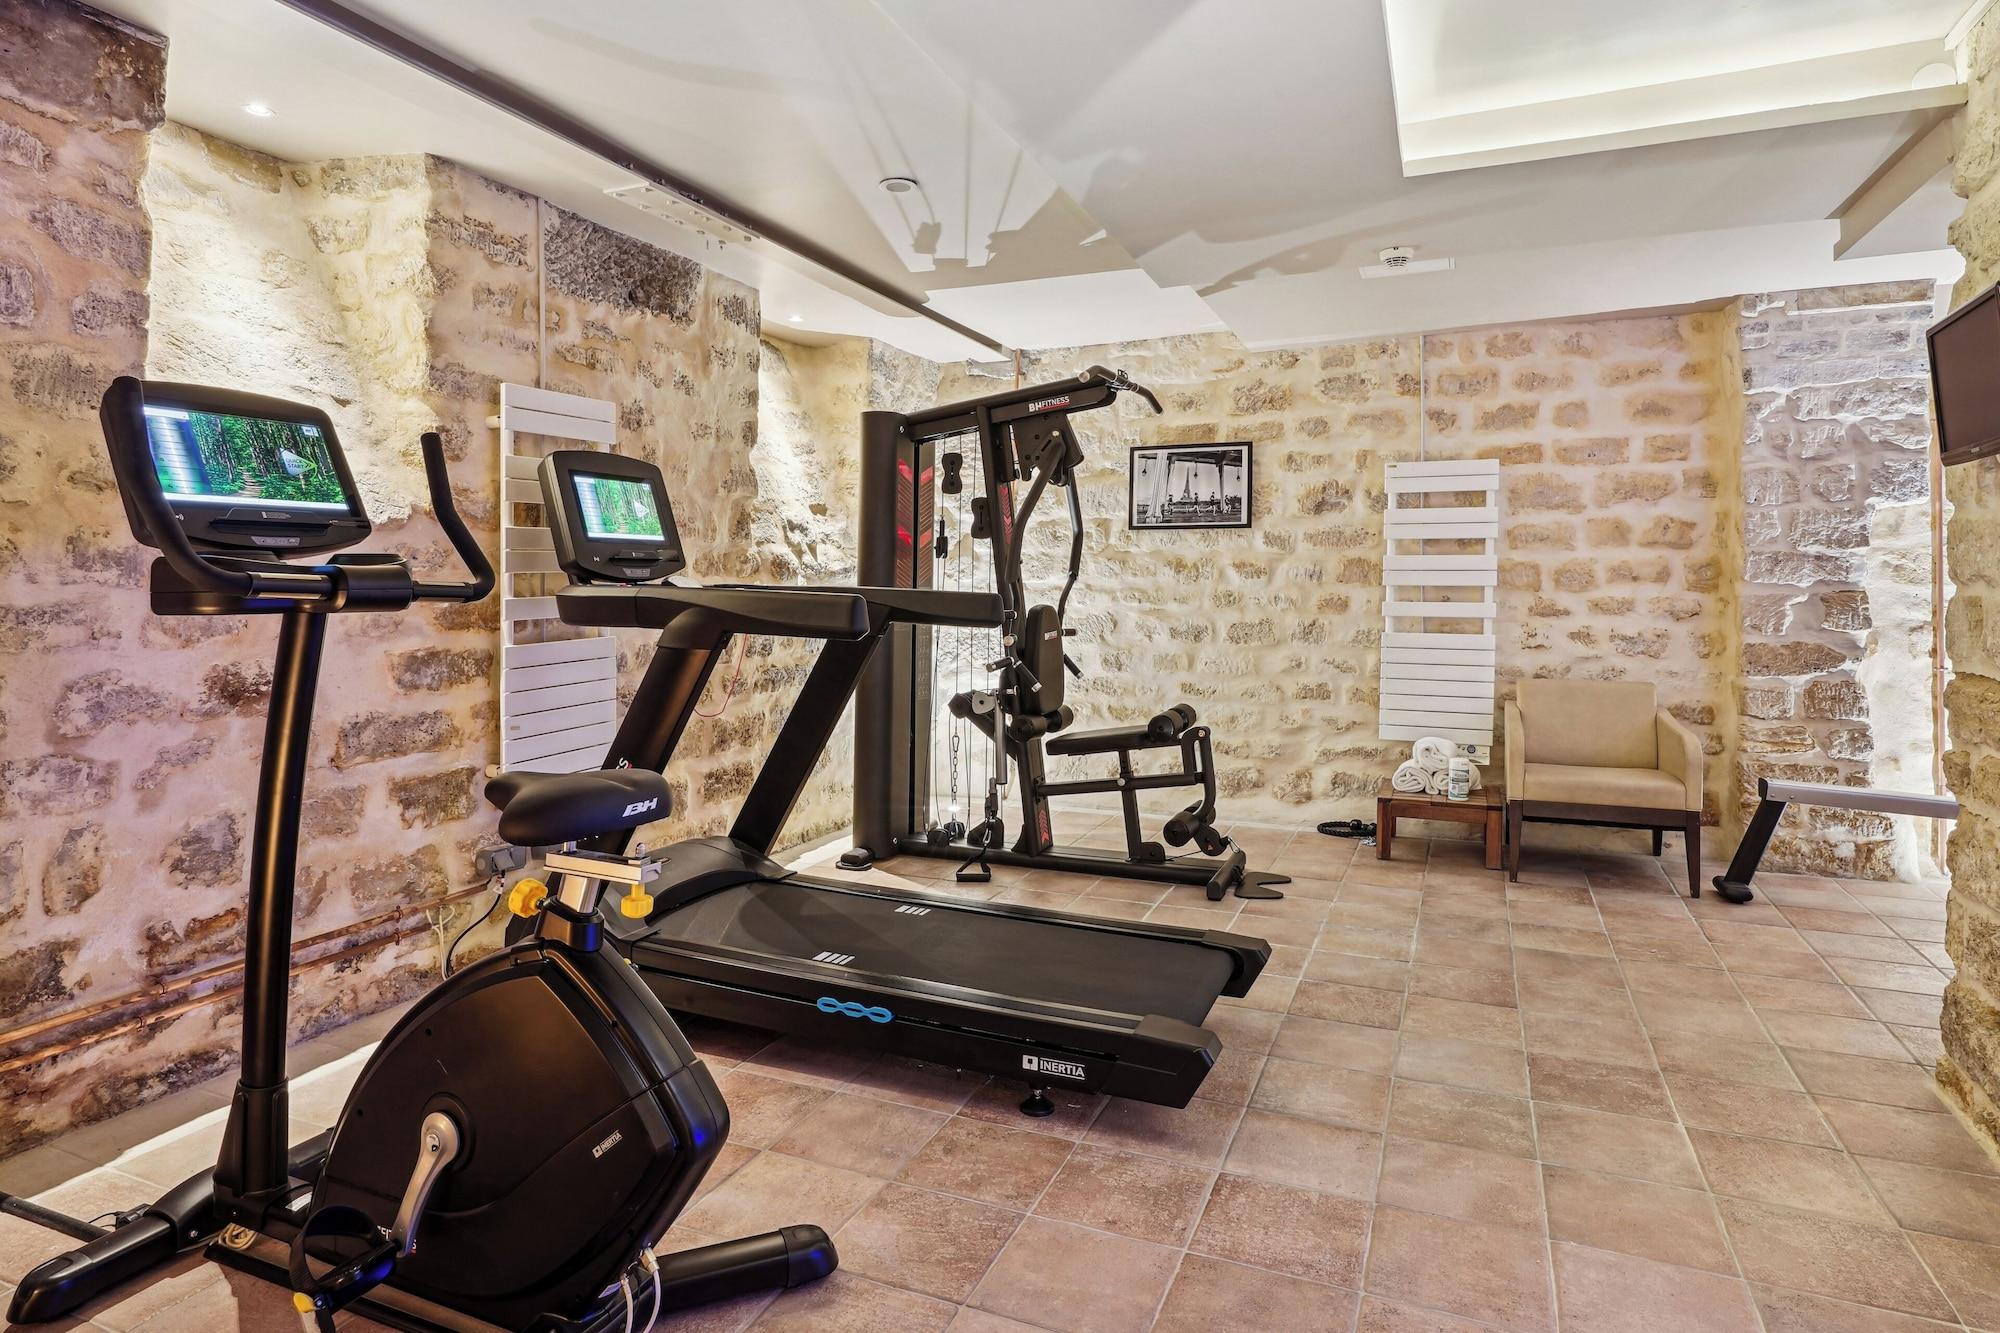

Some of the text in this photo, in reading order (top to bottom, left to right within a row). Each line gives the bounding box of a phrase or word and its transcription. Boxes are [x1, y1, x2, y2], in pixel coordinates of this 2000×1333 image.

[622, 797, 658, 818] BH
[1040, 1060, 1085, 1077] INERTIA
[600, 1132, 622, 1152] INERTIA
